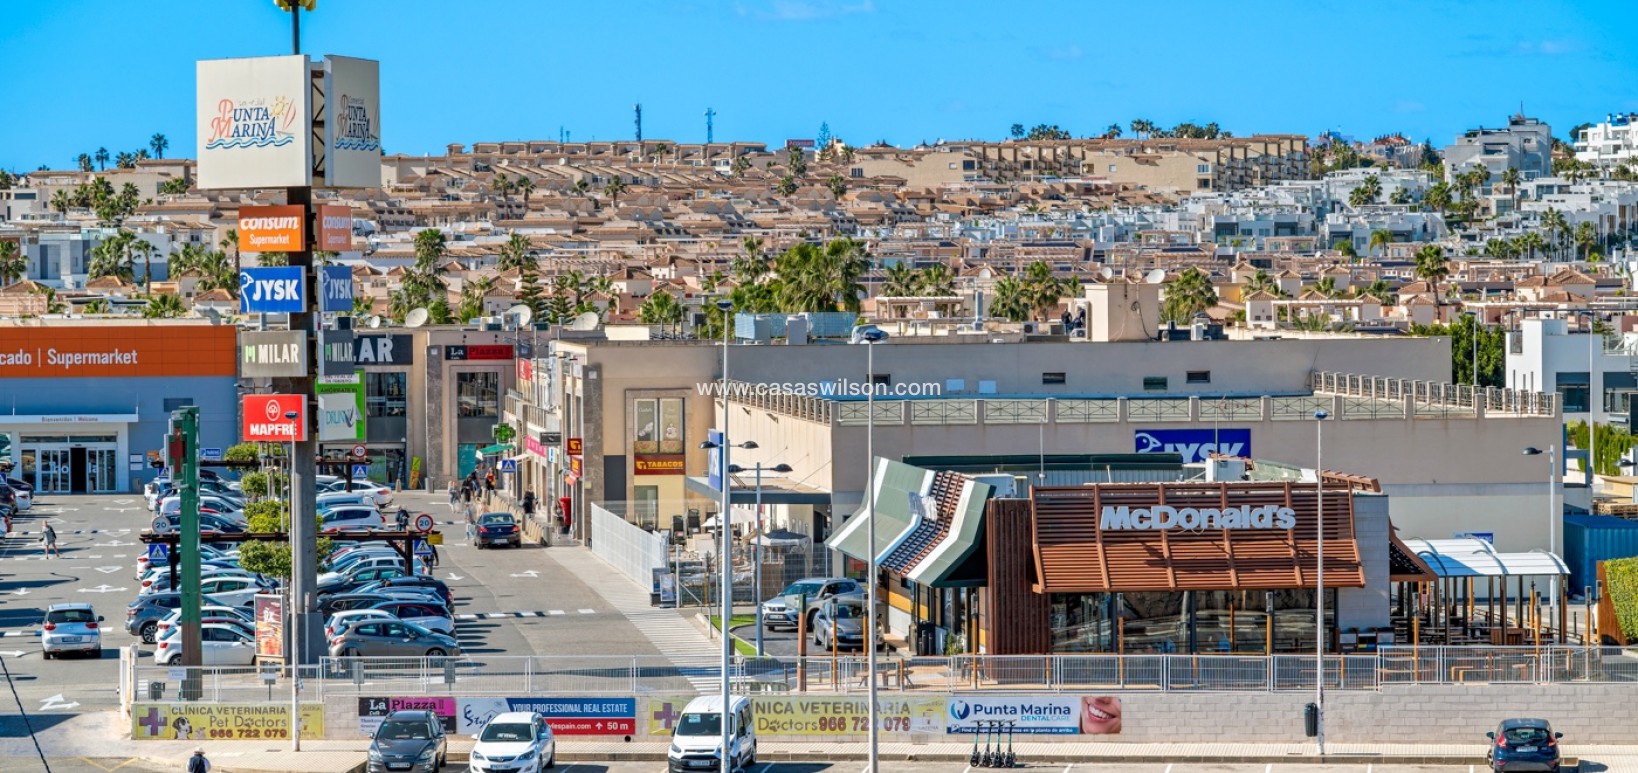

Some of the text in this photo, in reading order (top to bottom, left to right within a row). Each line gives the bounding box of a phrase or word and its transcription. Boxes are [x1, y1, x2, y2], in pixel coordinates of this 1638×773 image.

[219, 99, 270, 122] PUNTA
[208, 117, 275, 142] MARINA
[240, 216, 299, 231] consum
[249, 234, 290, 248] Supermarket
[253, 279, 300, 301] JYSK
[329, 279, 352, 300] JYSK
[47, 348, 138, 369] Supermarket
[258, 344, 299, 364] MILAR
[332, 343, 354, 363] MILAR
[450, 347, 464, 355] La
[419, 519, 430, 527] 20
[1100, 505, 1297, 530] McDonald's
[171, 704, 287, 715] CLÍNICA VETERINARIA
[369, 699, 387, 710] La
[391, 699, 436, 710] Plazza
[513, 703, 628, 713] YOUR PROFESSIONAL REAL ESTATE
[974, 703, 1072, 716] Punta Marina
[210, 716, 228, 728] Pet
[463, 704, 492, 729] Styl
[818, 716, 846, 731] 966
[209, 728, 233, 738] 966
[237, 728, 261, 738] 722
[607, 721, 619, 730] 50
